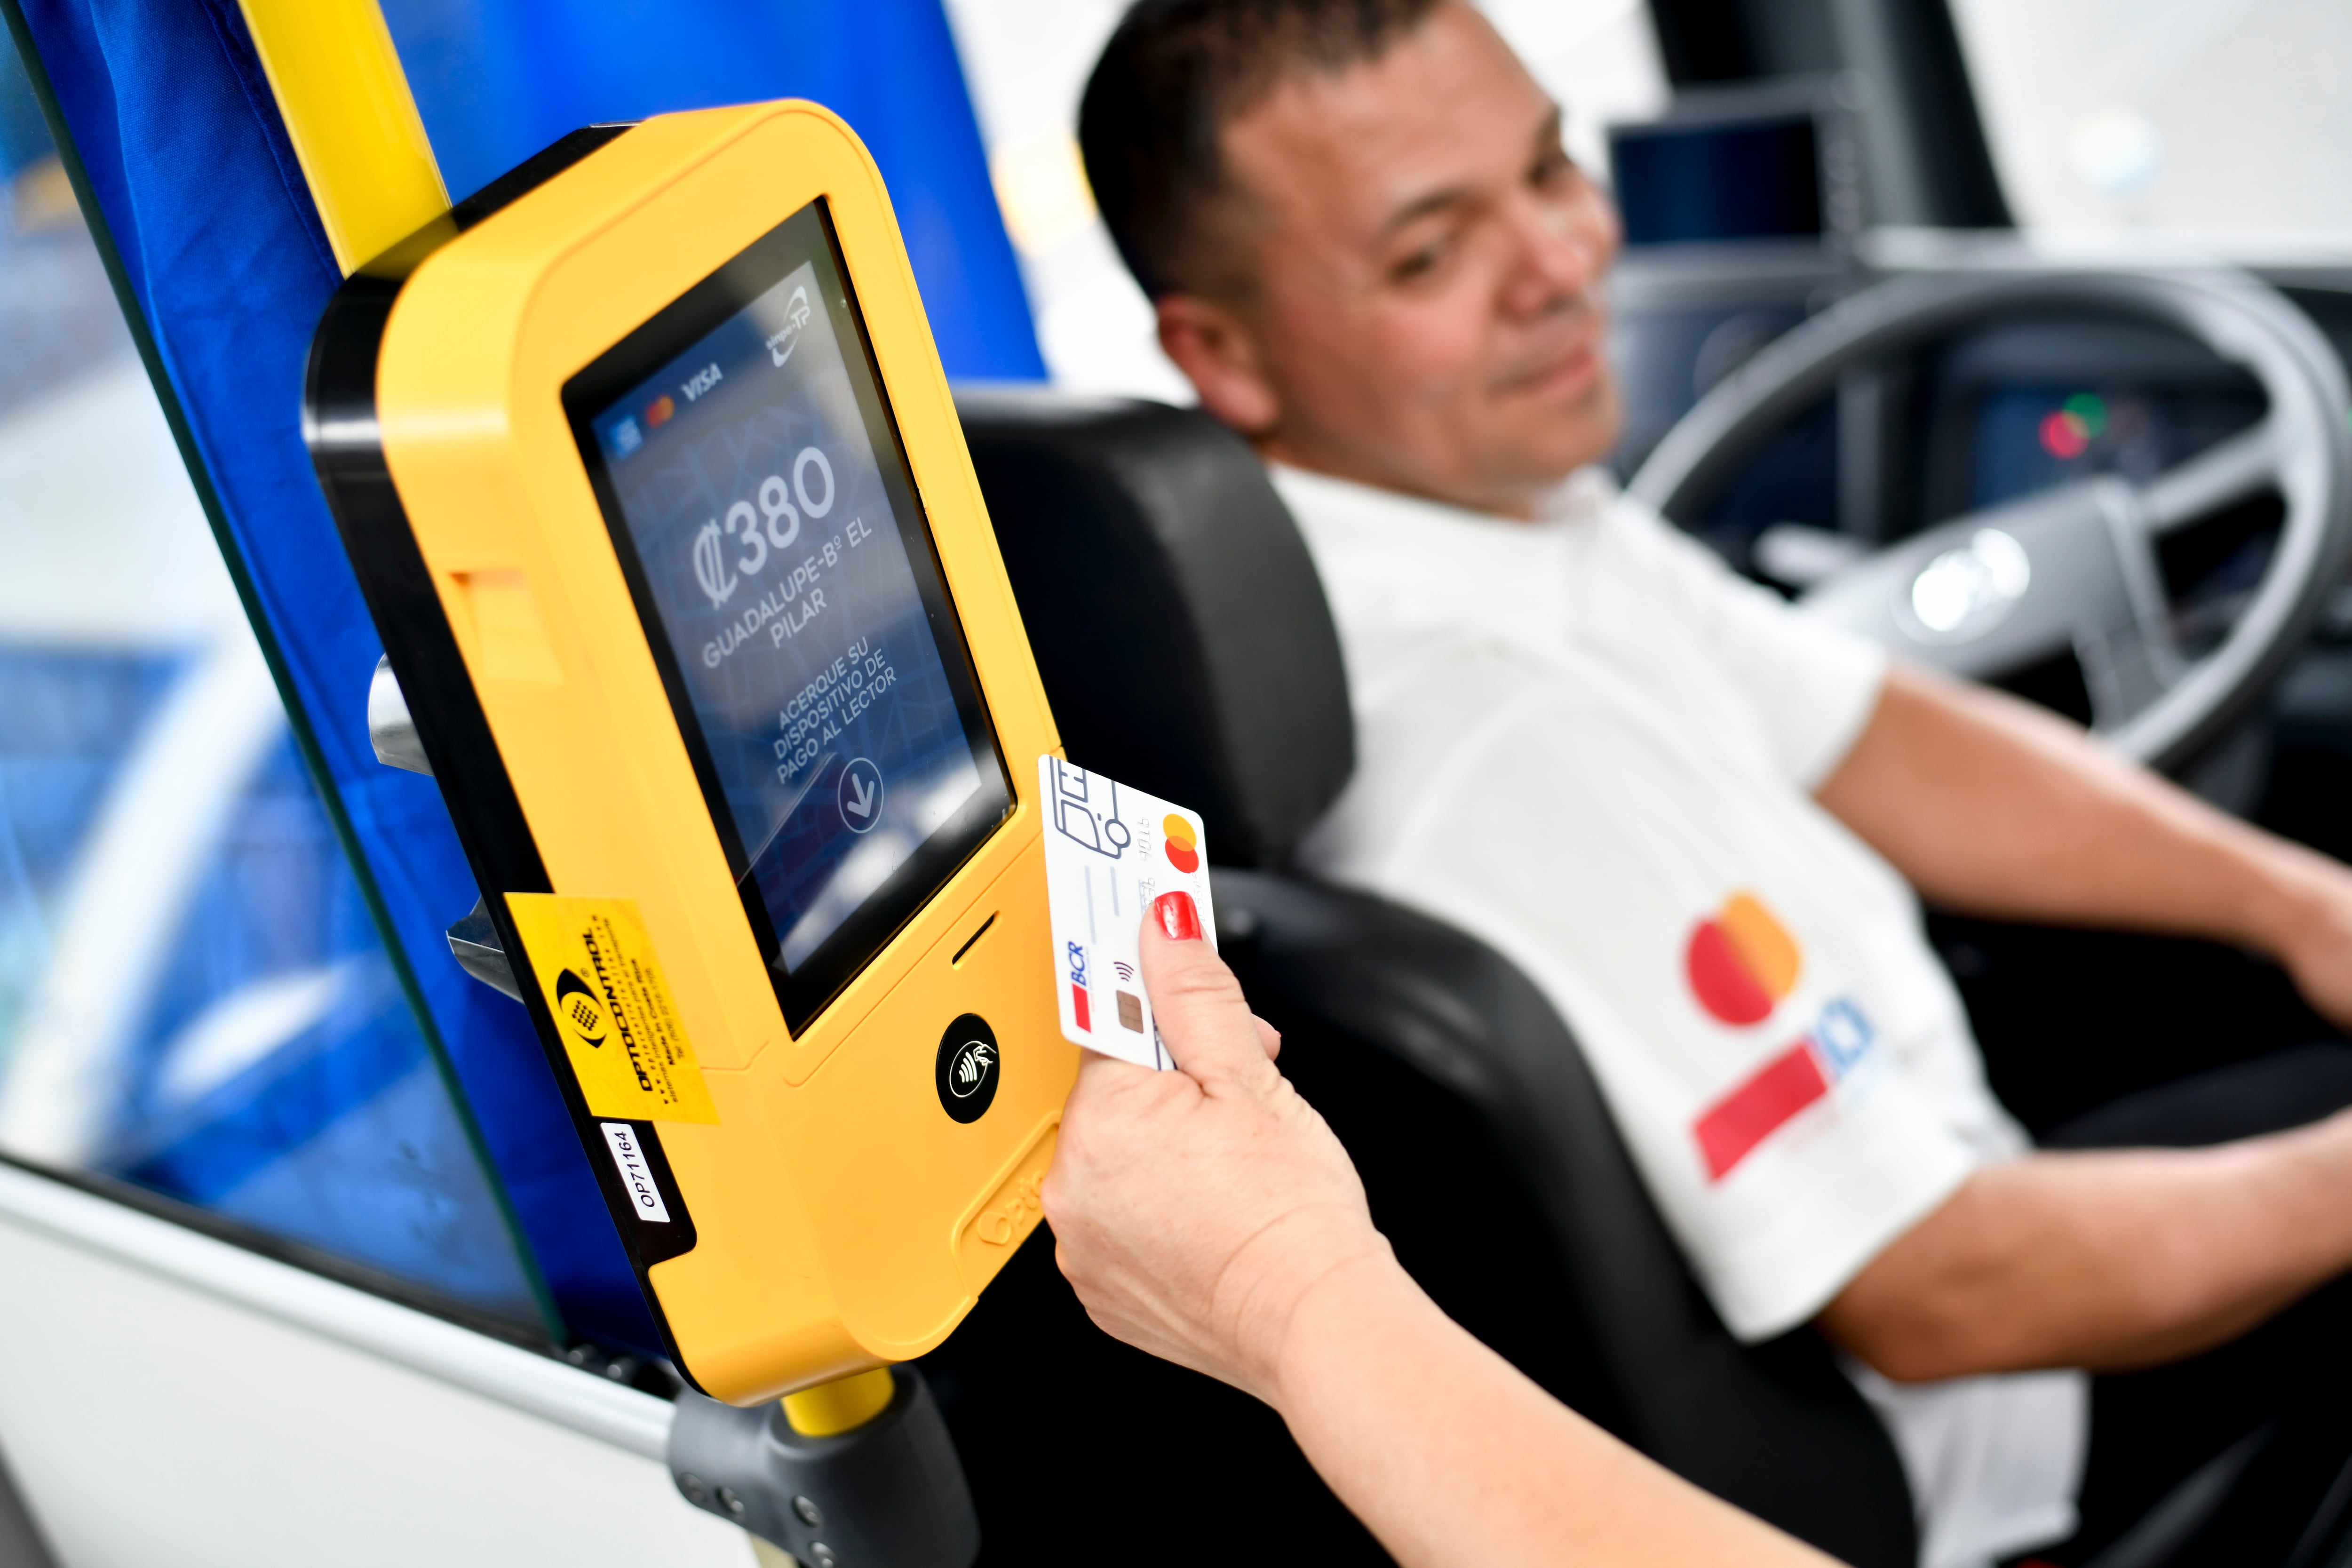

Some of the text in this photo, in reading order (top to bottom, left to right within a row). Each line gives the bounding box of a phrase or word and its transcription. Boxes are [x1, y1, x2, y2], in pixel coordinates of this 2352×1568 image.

[680, 362, 723, 402] VISA
[846, 517, 872, 548] EL
[770, 588, 827, 649] PILAR
[774, 648, 885, 760] DISPOSITIVO DE
[779, 637, 868, 730] ACERQUE SU
[777, 667, 897, 784] PAGO AL LECTOR
[631, 959, 643, 983] Rica
[1068, 941, 1086, 987] BCR
[583, 929, 653, 1091] OPTOCONTROL
[642, 987, 657, 1019] Costa
[637, 1006, 661, 1058] inteligentes
[661, 1036, 675, 1065] Made
[660, 1062, 678, 1102] sistemas
[614, 1131, 655, 1207] OP71164
